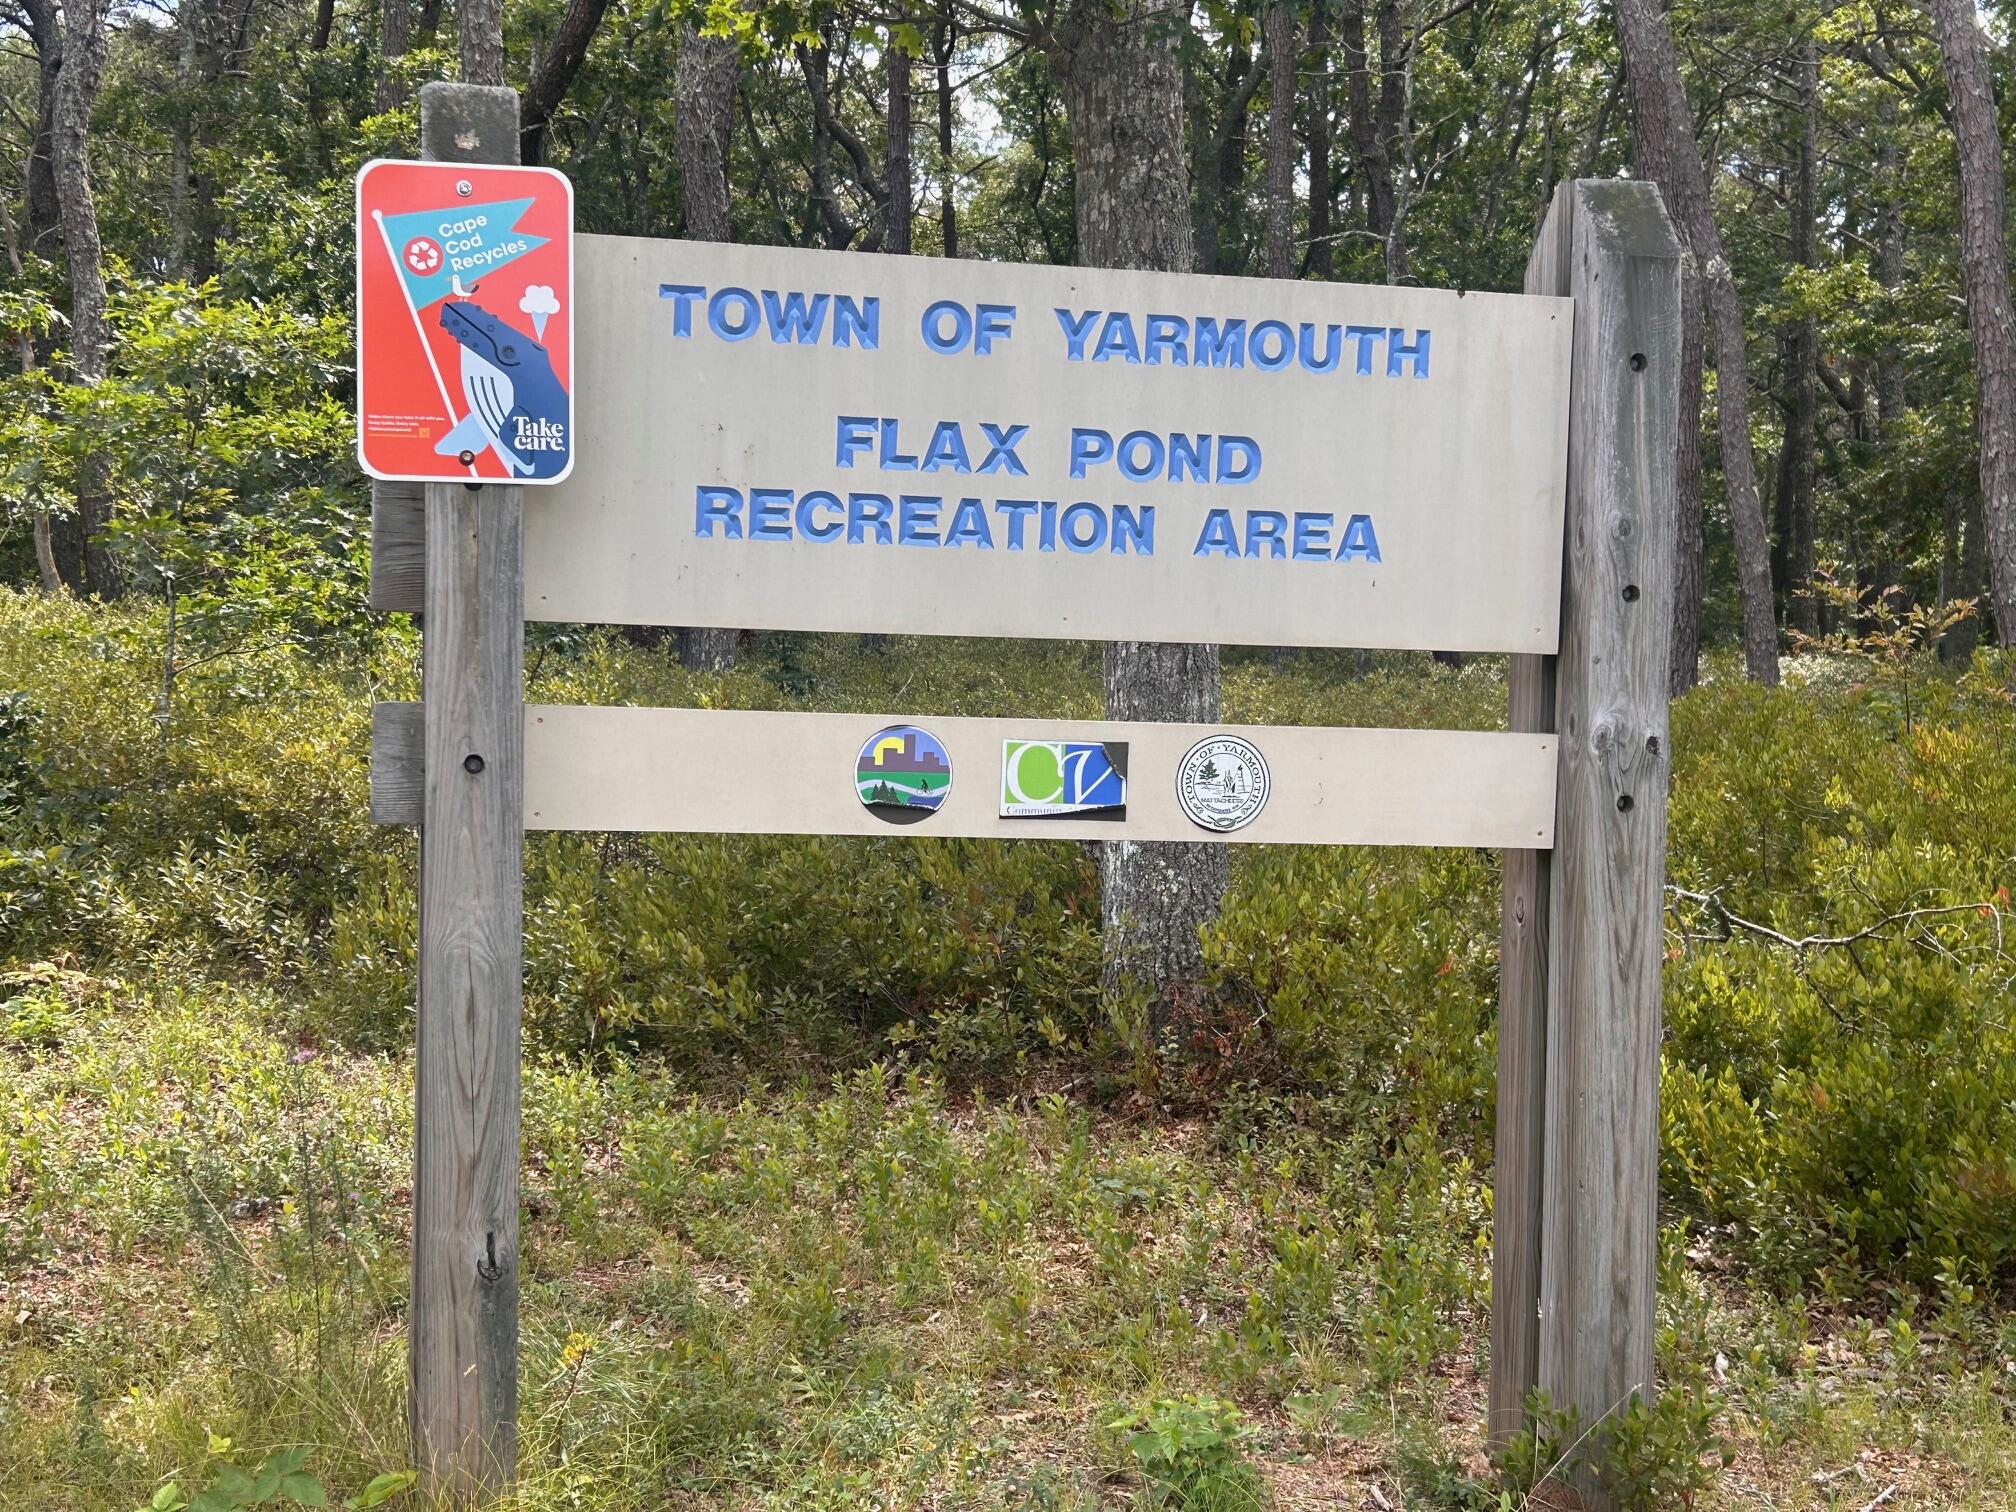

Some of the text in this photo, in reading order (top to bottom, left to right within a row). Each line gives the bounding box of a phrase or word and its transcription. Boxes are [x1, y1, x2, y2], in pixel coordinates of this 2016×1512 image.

[438, 215, 488, 238] Cape
[445, 232, 484, 255] Cod
[450, 239, 528, 272] Recycles
[659, 284, 1430, 379] TOWN OF YARMOUTH
[512, 416, 564, 437] Take
[836, 416, 1262, 485] FLAX POND
[696, 486, 1382, 563] RECREATION AREA
[1185, 762, 1198, 802] TOWN
[1222, 744, 1262, 805] YARMOUTH
